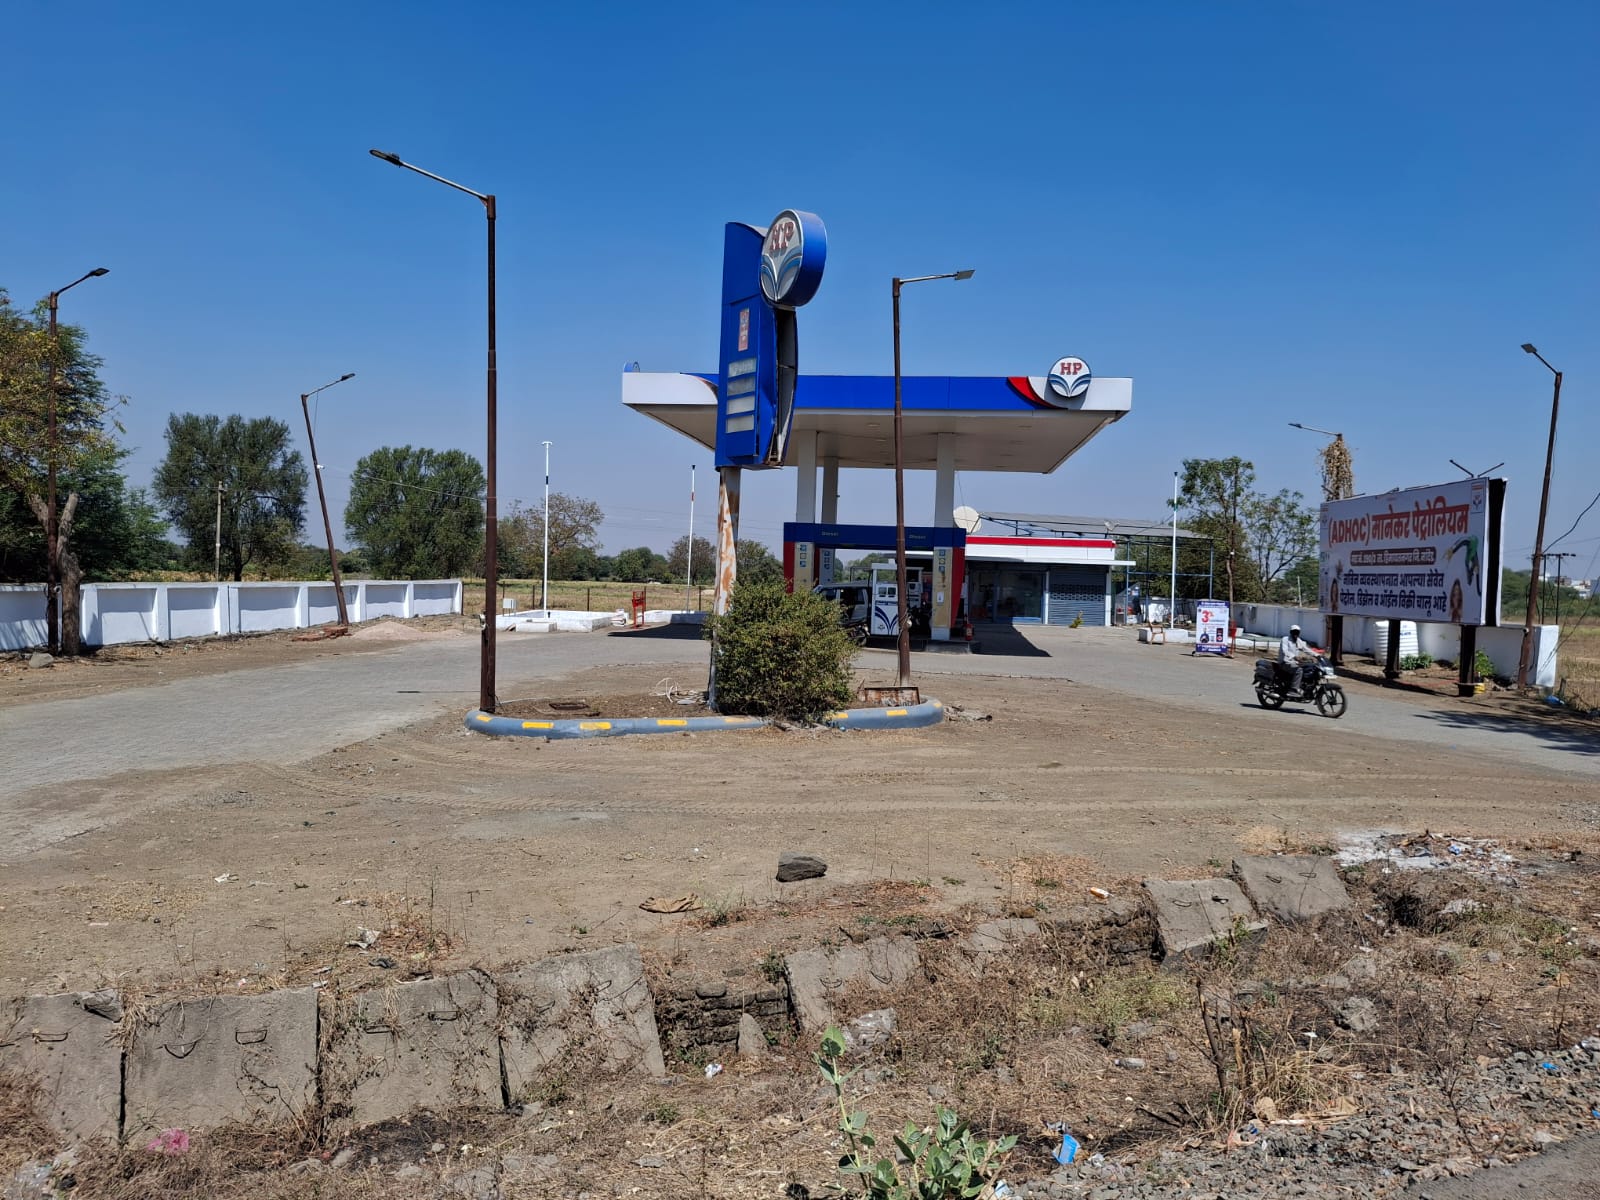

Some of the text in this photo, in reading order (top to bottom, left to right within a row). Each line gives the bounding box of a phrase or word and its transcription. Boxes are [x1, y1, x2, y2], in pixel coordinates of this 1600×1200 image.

[770, 222, 794, 250] HP
[1060, 362, 1082, 375] HP
[1328, 496, 1469, 547] (ADHOC) मानेकर पेट्रोलियम
[1399, 573, 1426, 587] आपल्या
[1426, 569, 1445, 587] सेवेत
[1374, 594, 1379, 607] व
[1416, 595, 1432, 617] चालू
[1432, 591, 1447, 612] आहे
